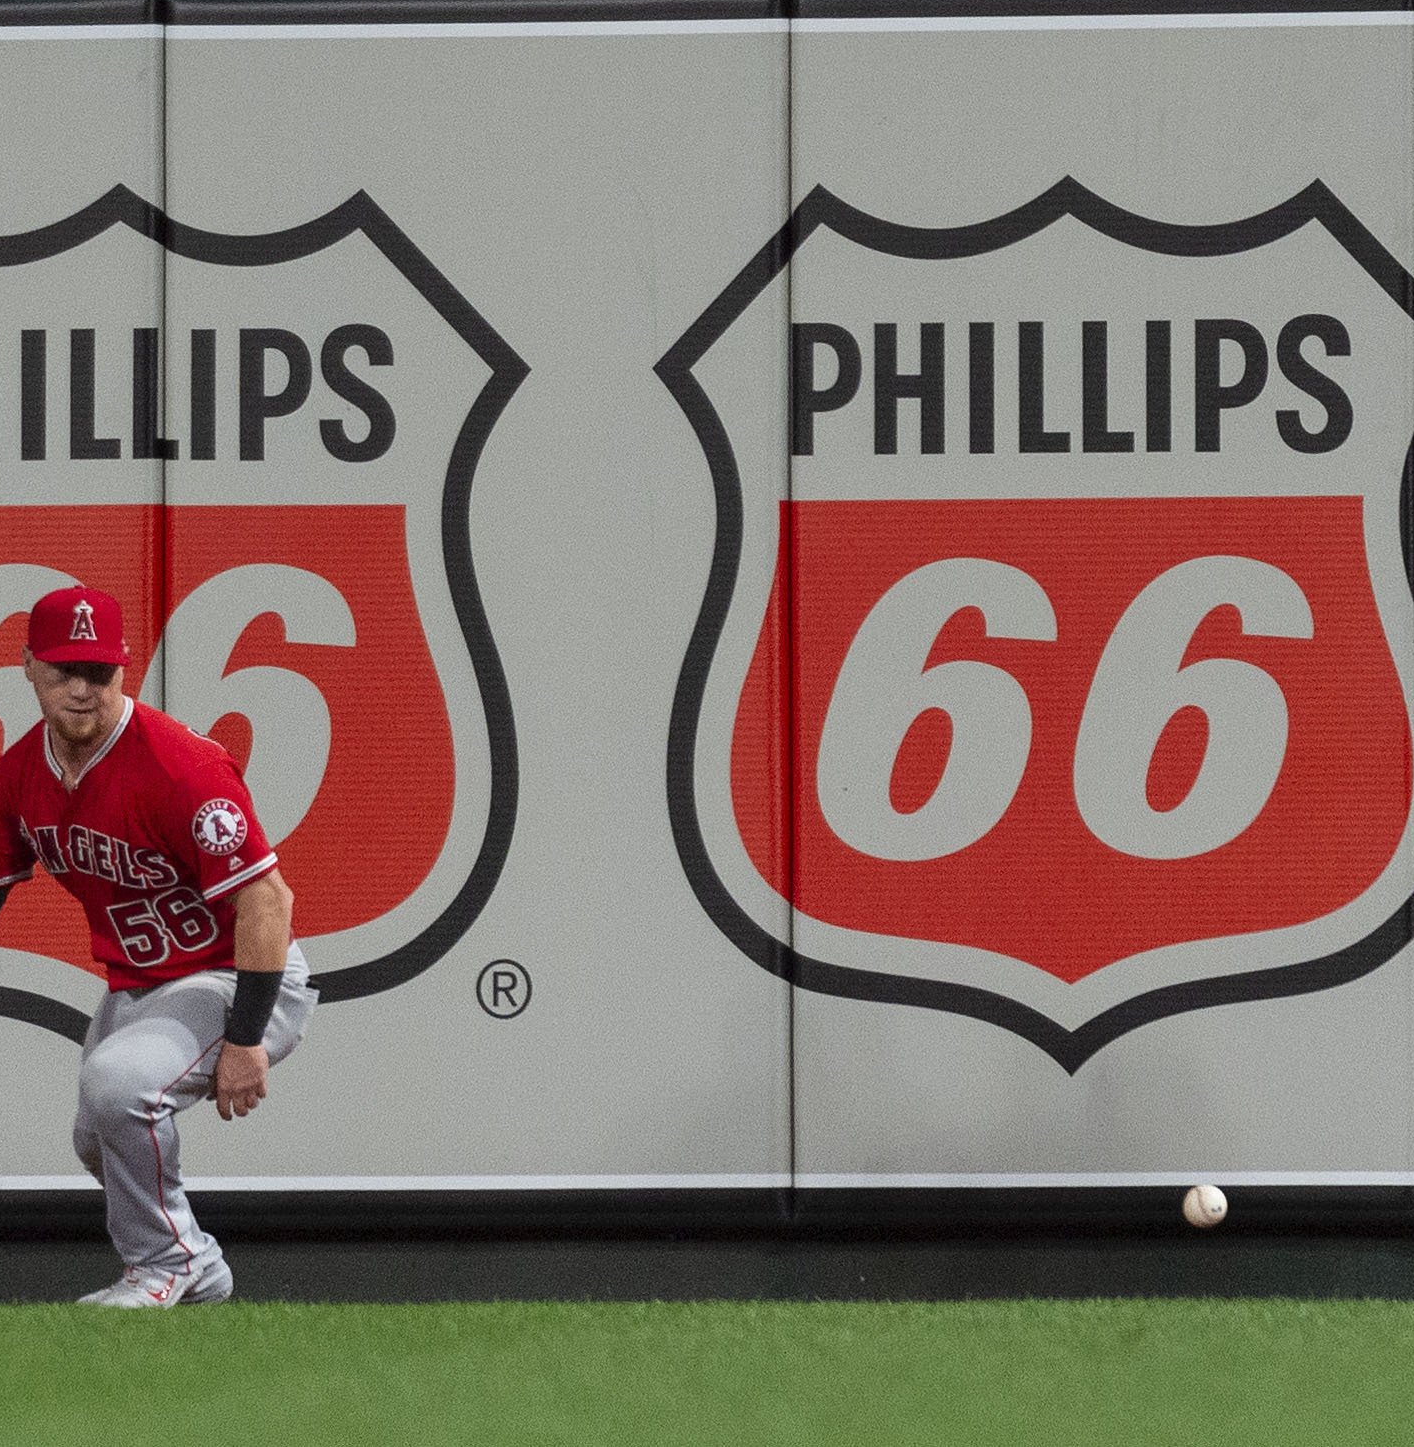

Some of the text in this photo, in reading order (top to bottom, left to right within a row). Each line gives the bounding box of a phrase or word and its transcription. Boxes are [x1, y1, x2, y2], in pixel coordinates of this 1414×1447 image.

[791, 313, 1355, 457] PHILLIPS
[816, 555, 1315, 862] 66
[104, 885, 219, 968] 56
